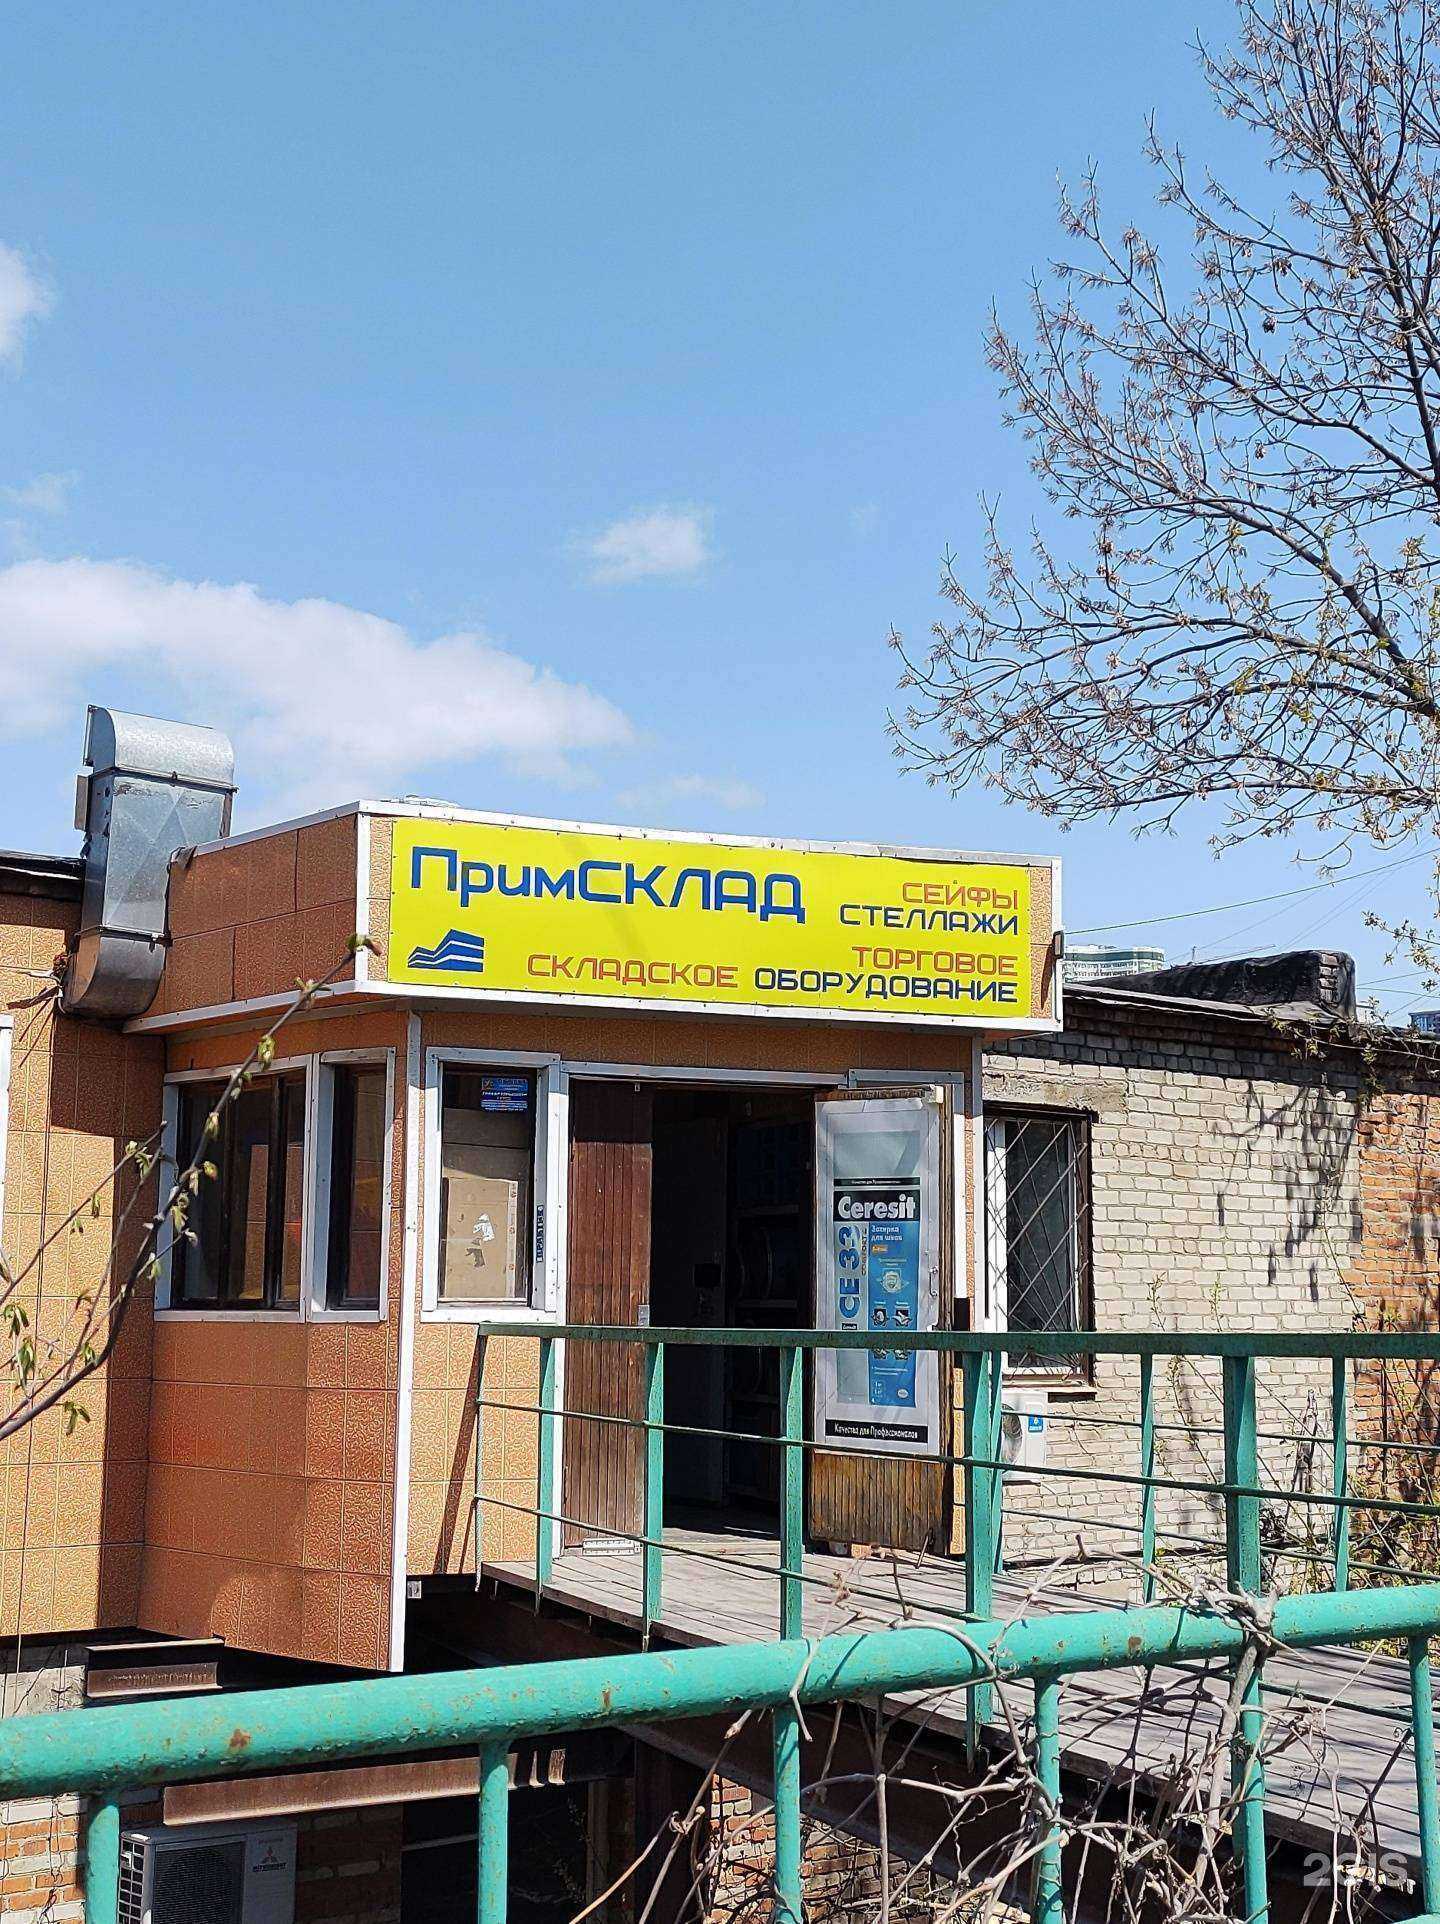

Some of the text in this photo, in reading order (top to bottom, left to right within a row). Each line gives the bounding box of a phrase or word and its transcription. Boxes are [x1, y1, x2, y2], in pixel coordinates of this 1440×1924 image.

[411, 846, 806, 924] ПримСКЛАД
[902, 878, 1019, 909] СЕЙФЫ
[840, 904, 1019, 936] СТЕЛЛАЖИ
[852, 947, 1018, 977] ТОРГОВОЕ
[528, 954, 1018, 1004] СКЛАДСКОЕ ОБОРУДОВАНИЕ
[837, 1193, 916, 1219] Ceresit
[838, 1225, 860, 1271] 33
[838, 1278, 860, 1319] CE
[859, 1427, 870, 1436] для
